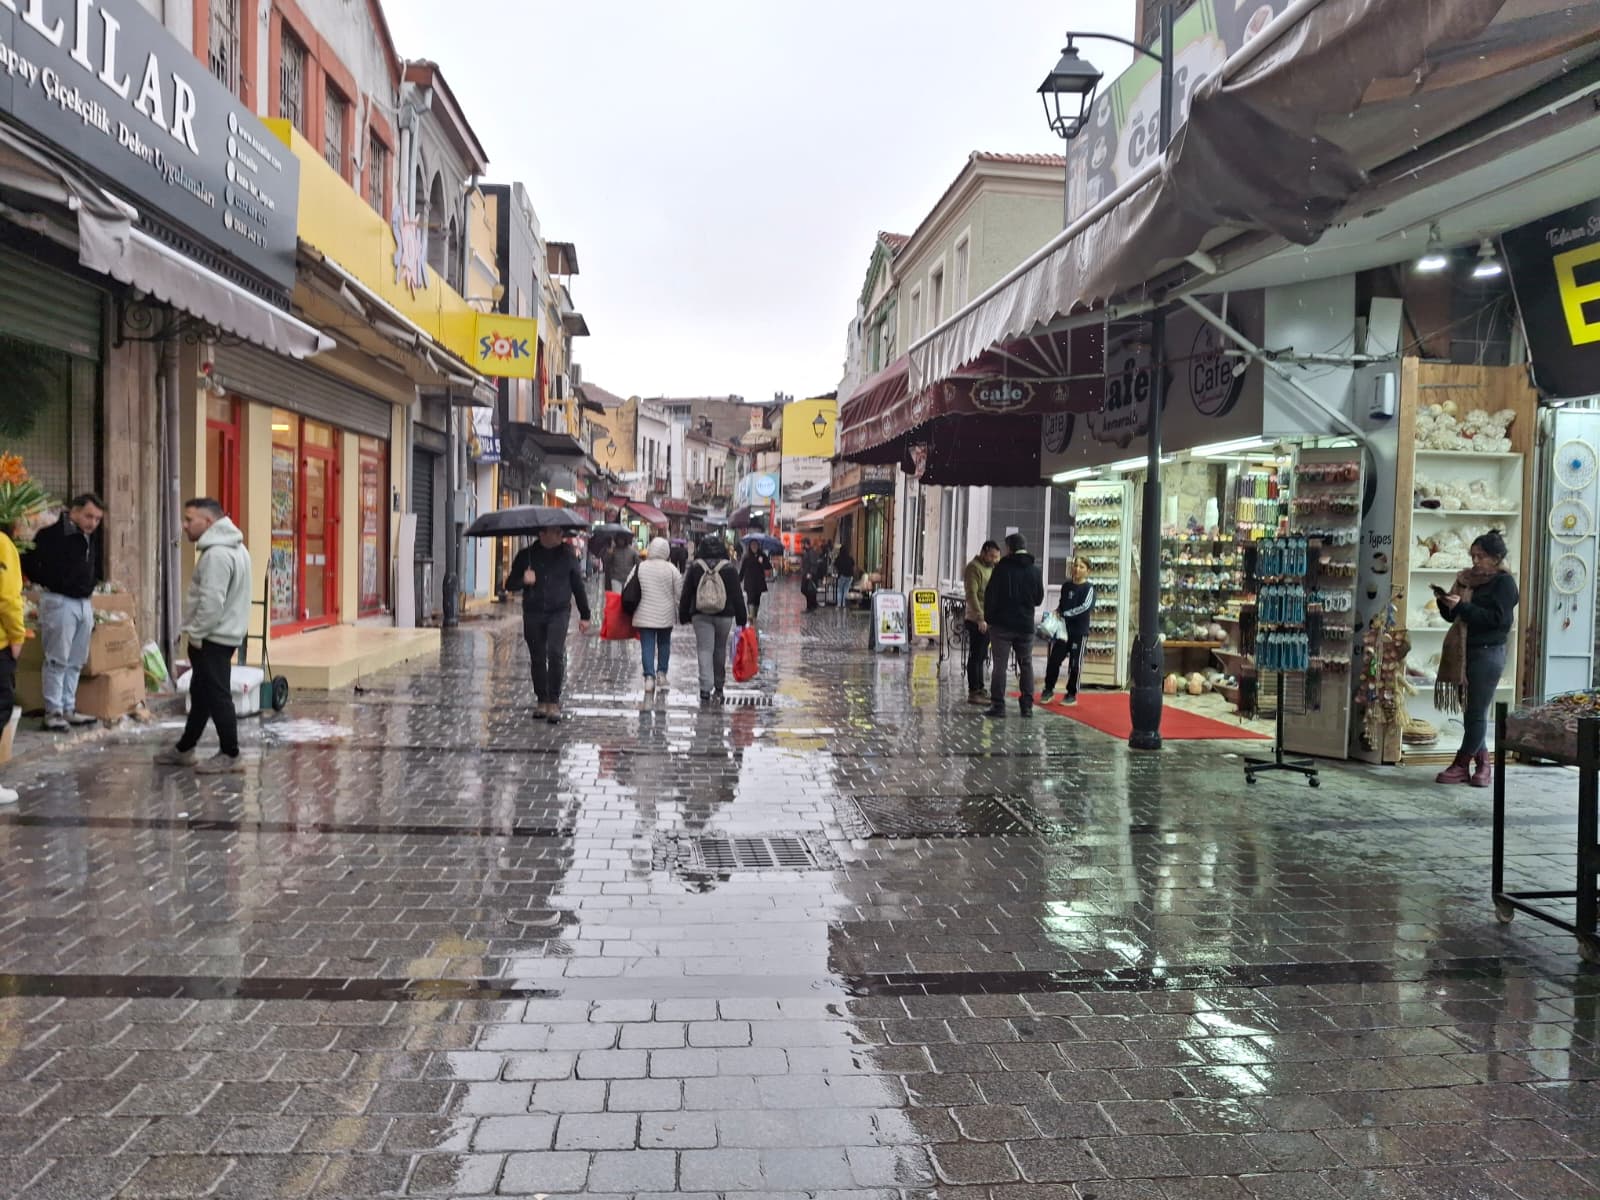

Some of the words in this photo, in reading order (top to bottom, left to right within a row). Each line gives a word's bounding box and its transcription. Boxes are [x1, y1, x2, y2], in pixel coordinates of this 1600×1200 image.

[0, 36, 38, 88] apay
[42, 66, 110, 135] Çiçekçilik
[118, 120, 153, 164] Dekor
[480, 331, 530, 361] ŞOK
[1104, 357, 1149, 412] afe
[1194, 355, 1231, 394] Cafe
[1368, 530, 1392, 549] Types
